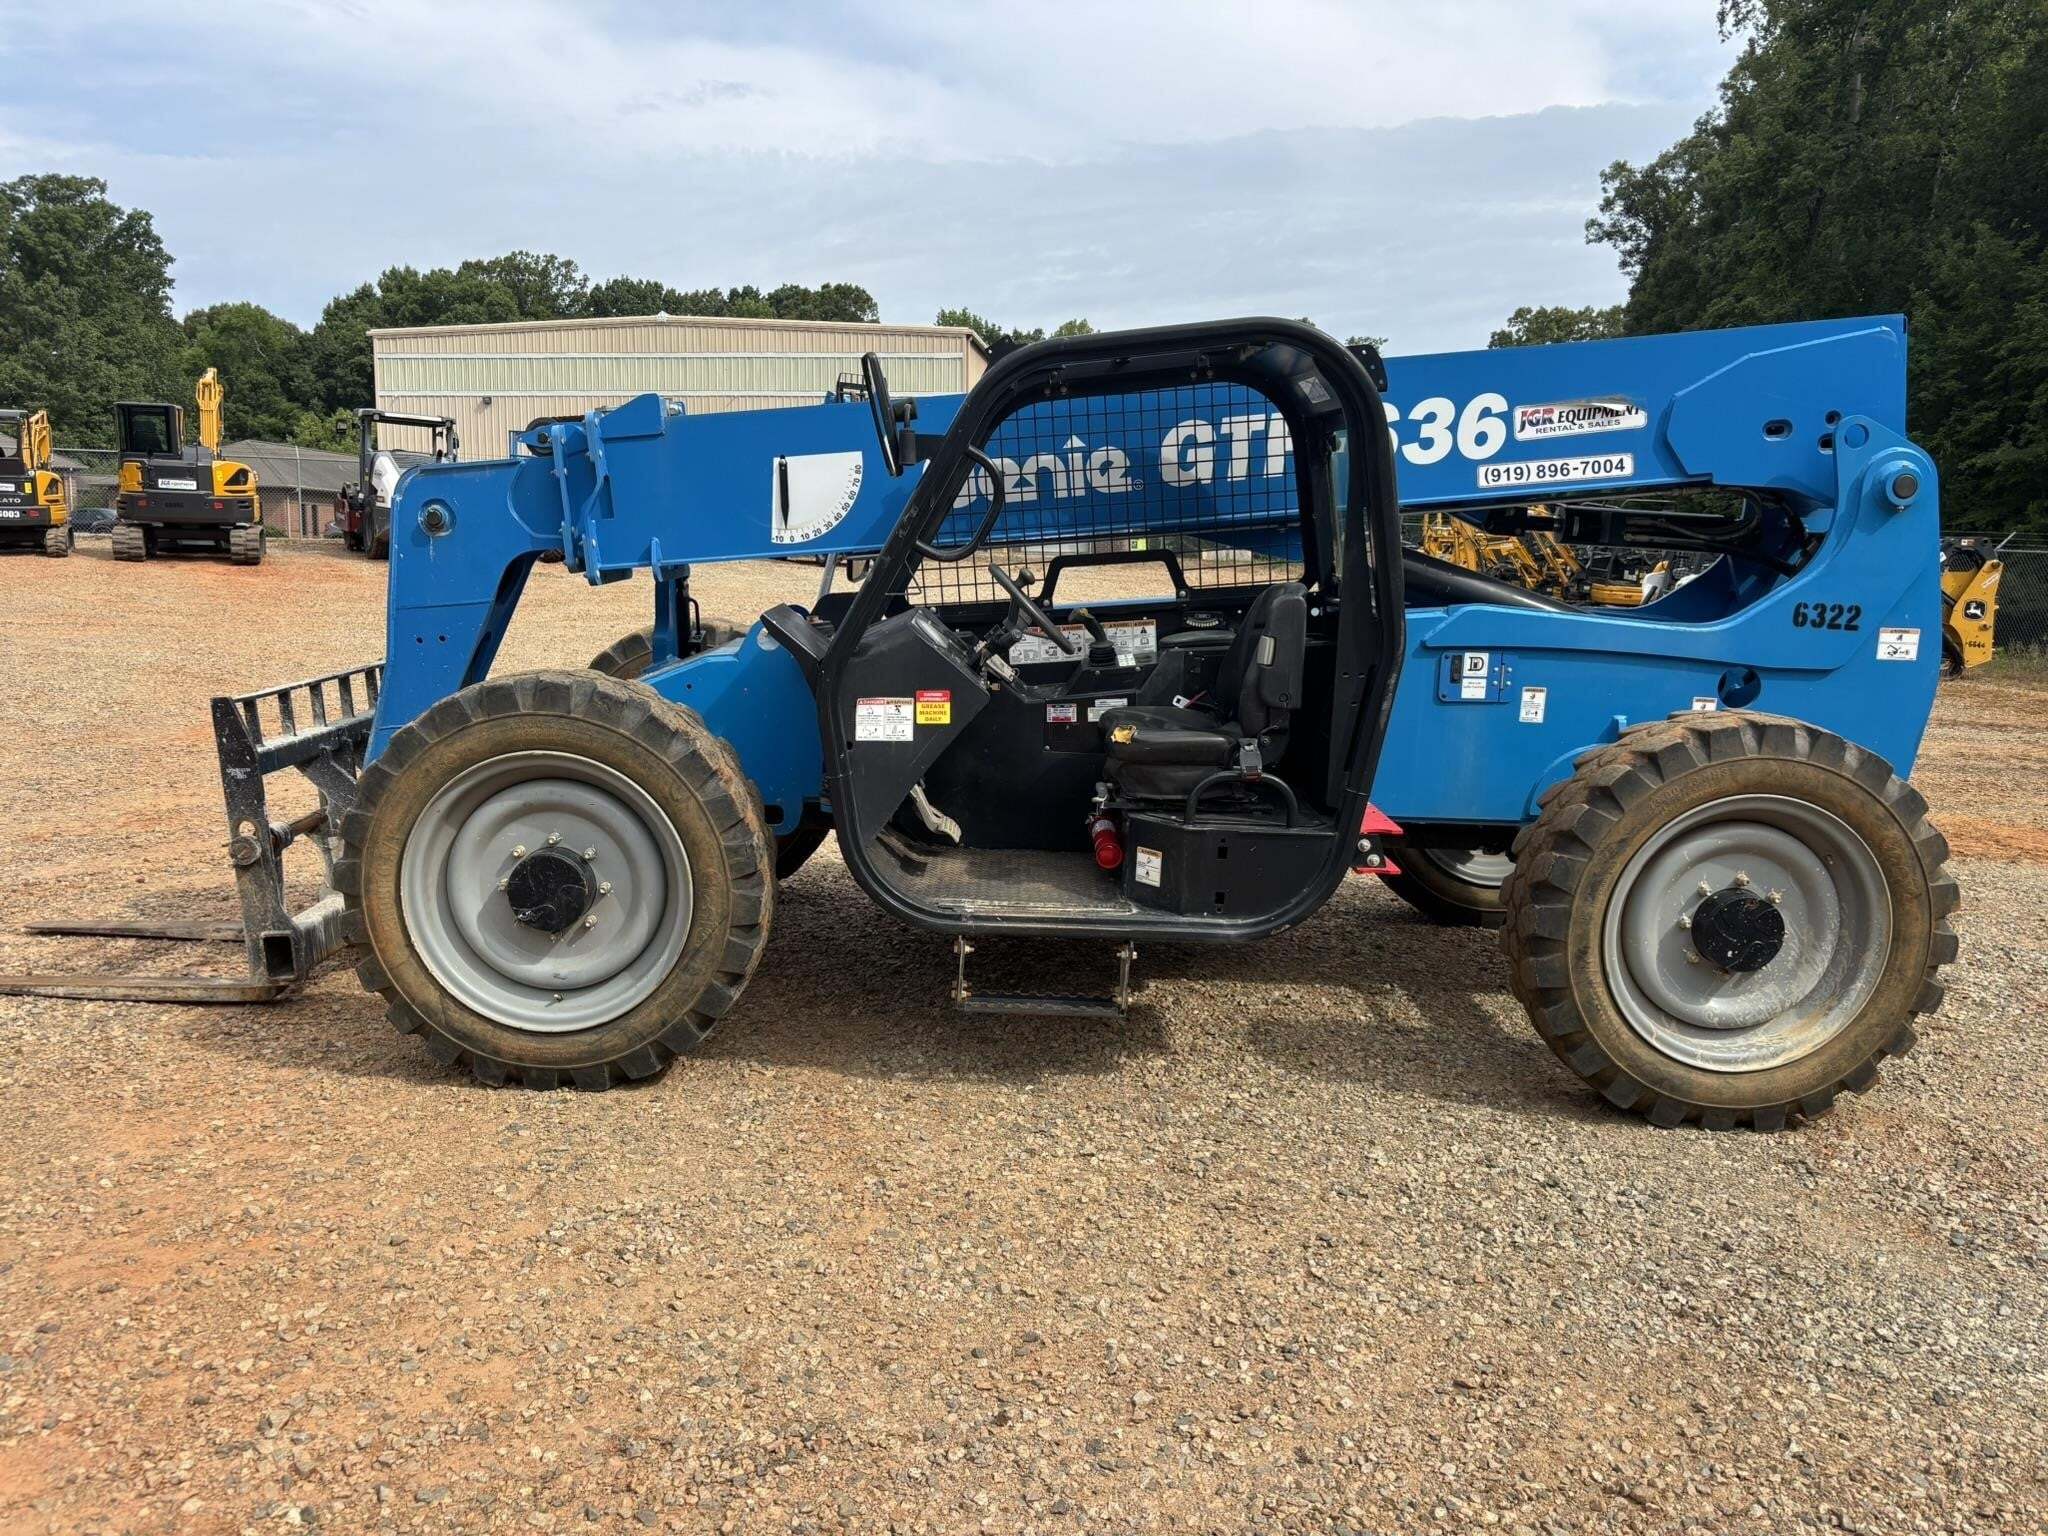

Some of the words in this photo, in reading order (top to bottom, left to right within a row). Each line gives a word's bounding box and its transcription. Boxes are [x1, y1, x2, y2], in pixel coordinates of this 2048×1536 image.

[1518, 407, 1556, 433] JGR
[1535, 424, 1575, 435] RENTAL
[1588, 419, 1621, 429] SALES
[854, 464, 862, 475] 80
[1484, 464, 1531, 484] (919)
[1536, 457, 1626, 479] 896-7004
[852, 477, 861, 488] 70
[848, 490, 857, 501] 60
[841, 502, 851, 512] 50
[833, 512, 843, 522] 40
[823, 521, 833, 531] 30
[801, 533, 810, 541] 10
[812, 527, 822, 537] 20
[1792, 602, 1863, 631] 6322
[1467, 656, 1485, 672] D
